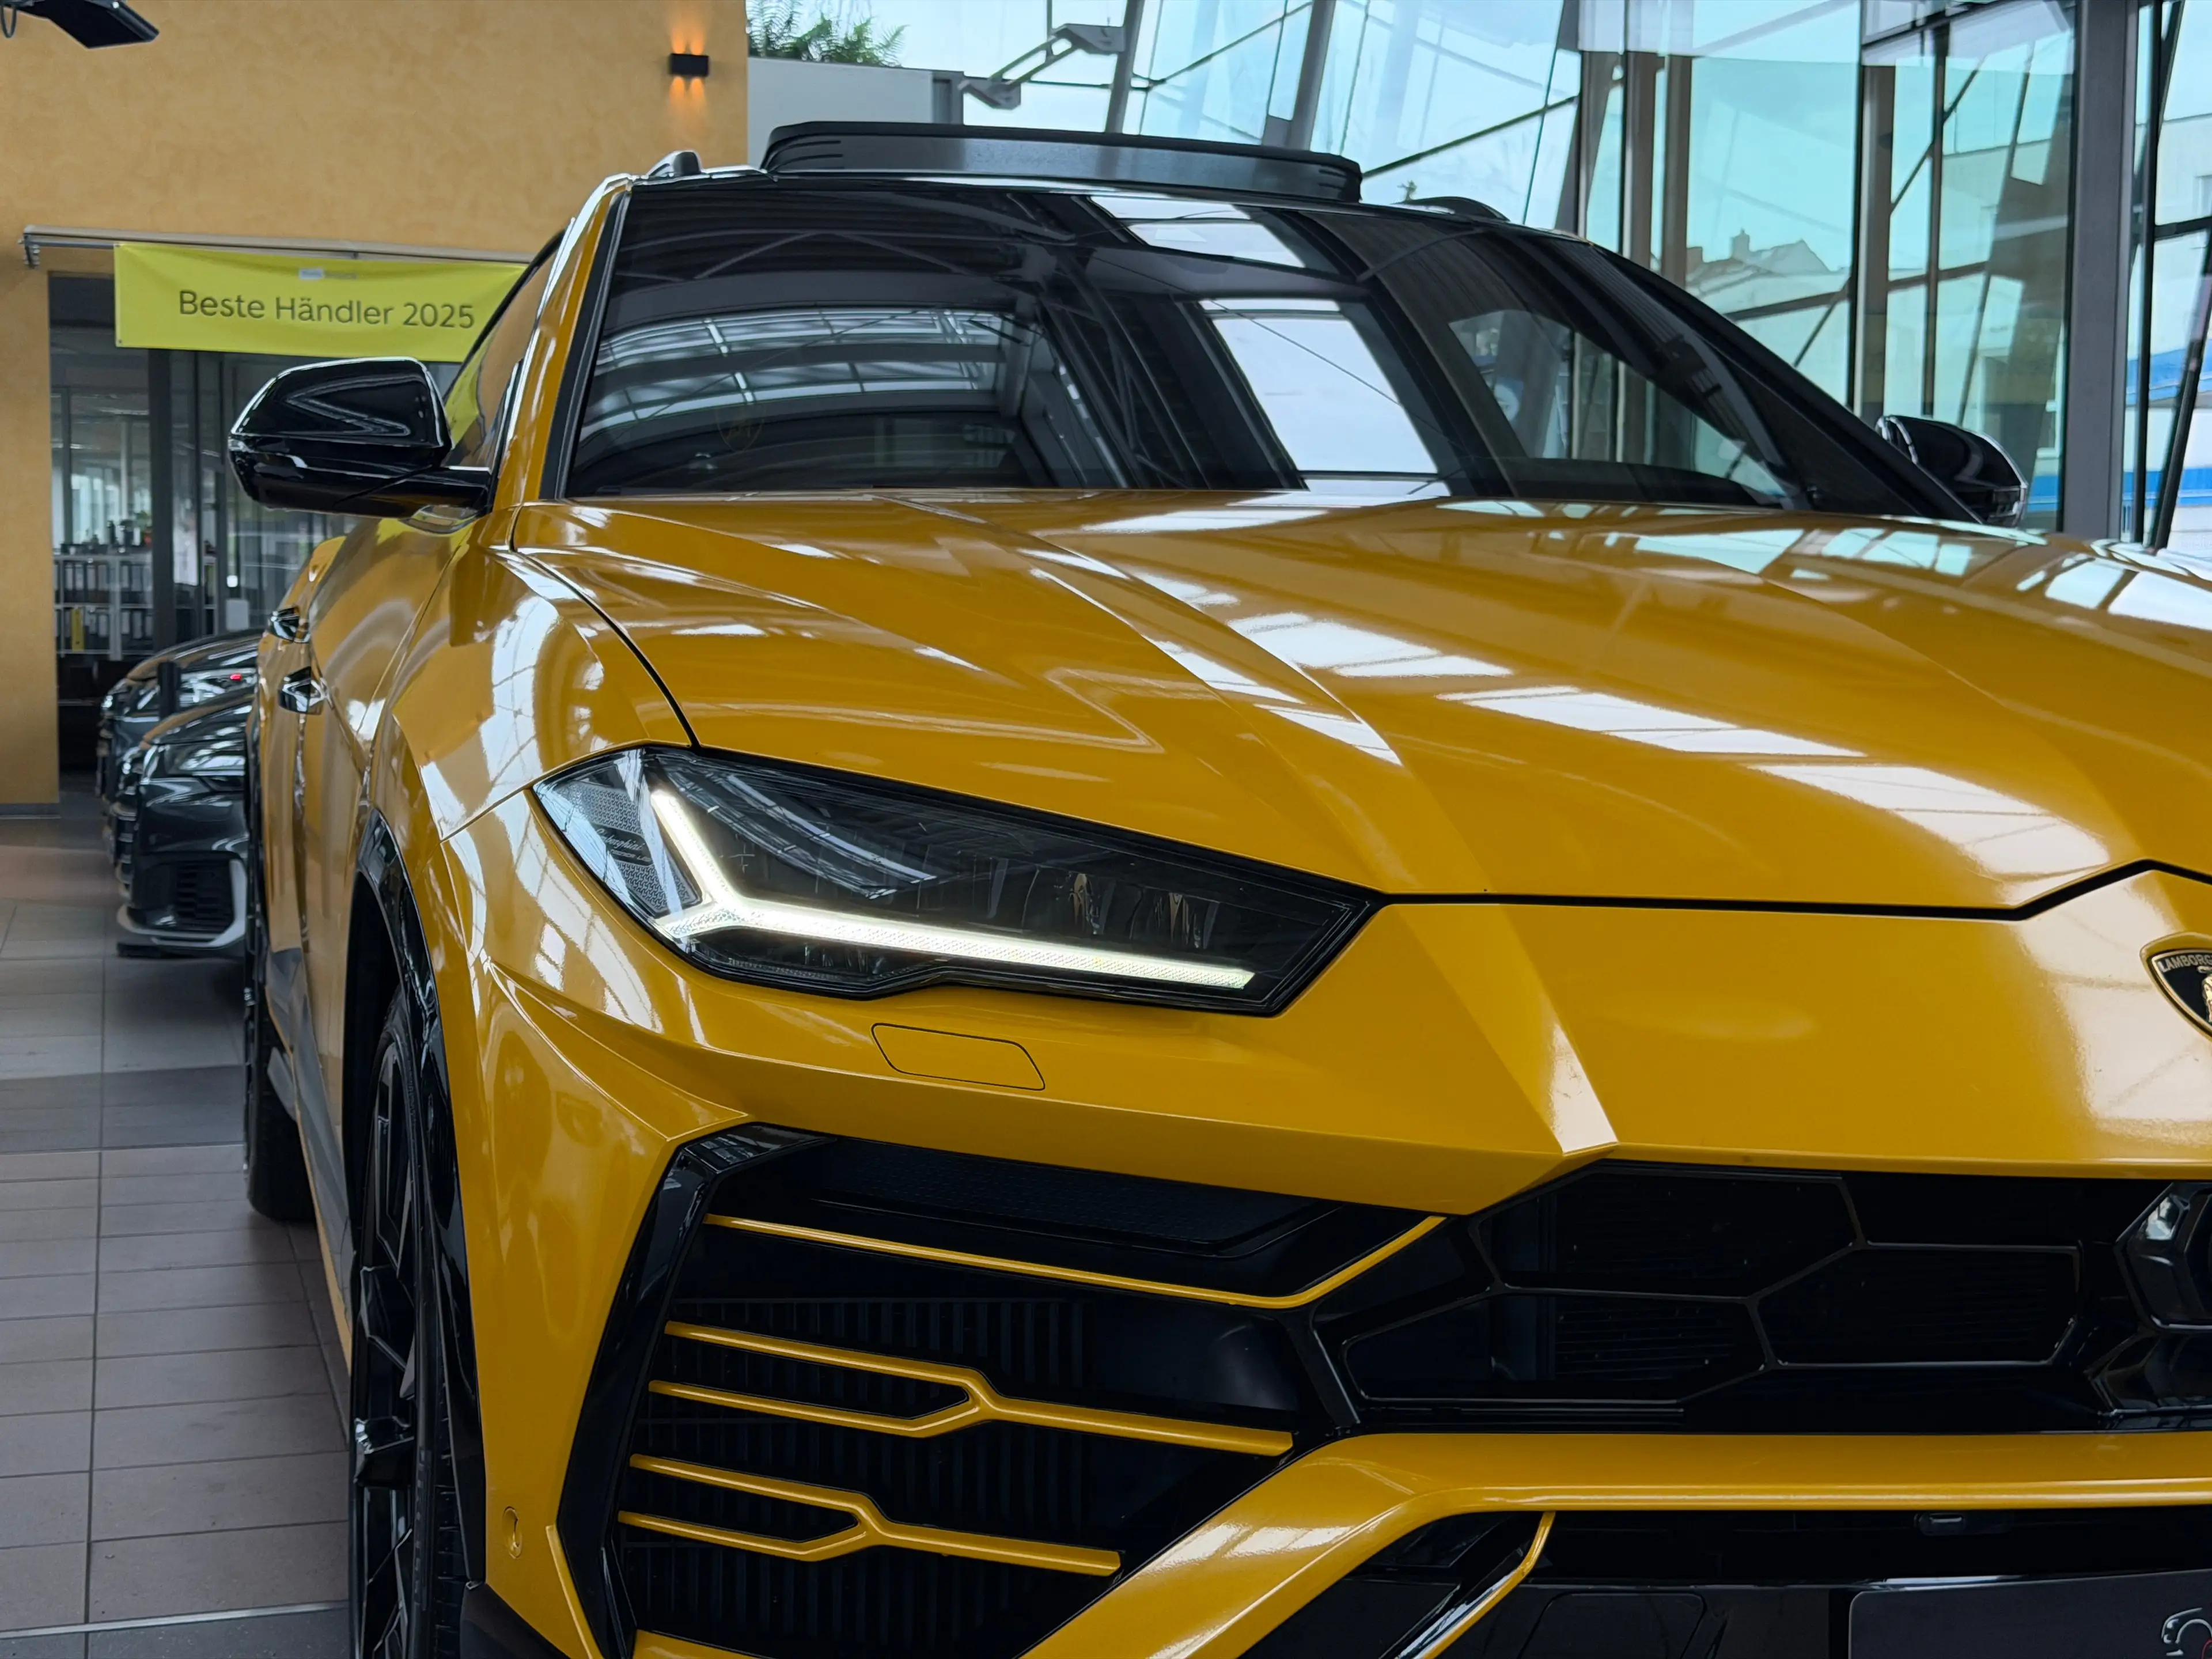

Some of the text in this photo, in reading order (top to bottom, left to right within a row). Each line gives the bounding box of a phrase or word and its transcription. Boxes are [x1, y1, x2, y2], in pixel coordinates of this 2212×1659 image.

[179, 290, 475, 328] Beste Händler 2025
